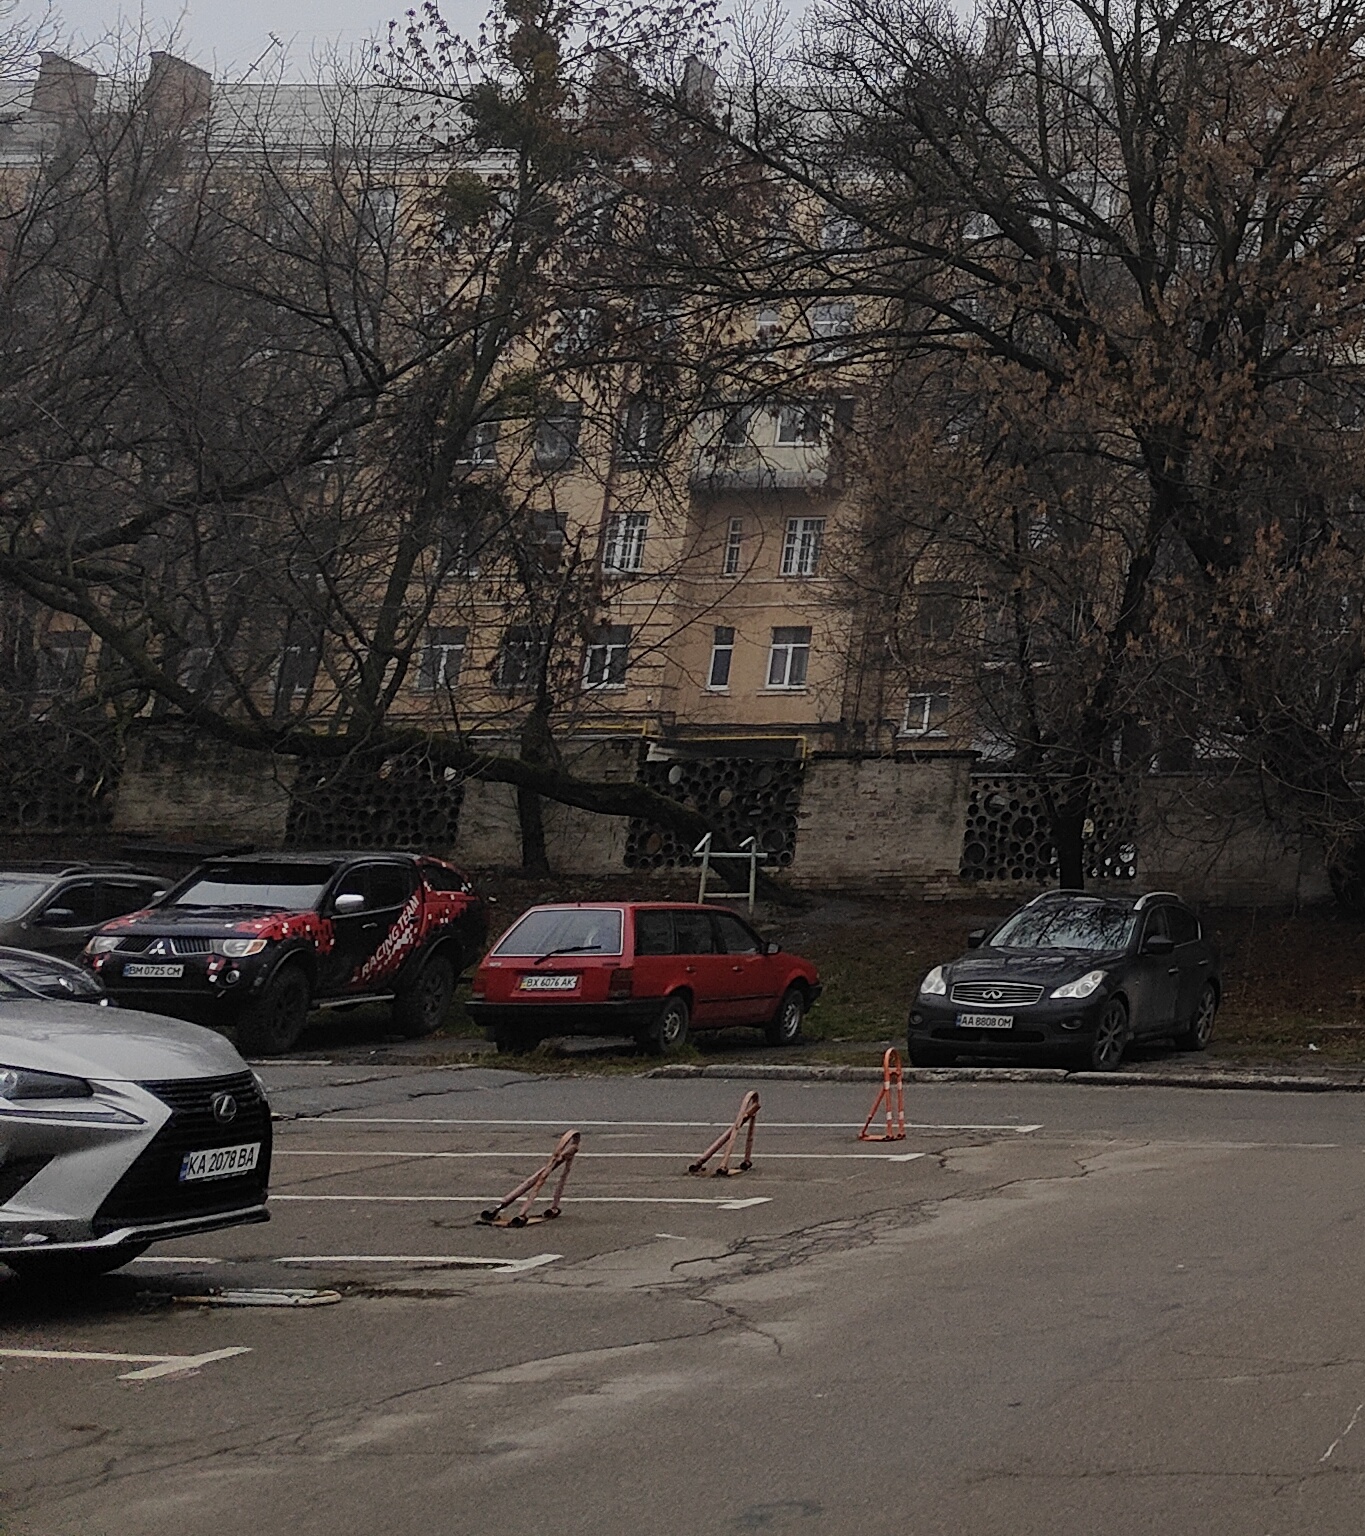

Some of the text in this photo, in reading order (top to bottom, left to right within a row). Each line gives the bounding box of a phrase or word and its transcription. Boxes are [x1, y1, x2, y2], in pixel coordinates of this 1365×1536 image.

[362, 895, 420, 978] RACING TEAM
[144, 966, 165, 976] 0725
[527, 978, 575, 987] BX 6076 AK
[962, 1017, 973, 1025] AA
[187, 1147, 254, 1175] KA 2078 BA
